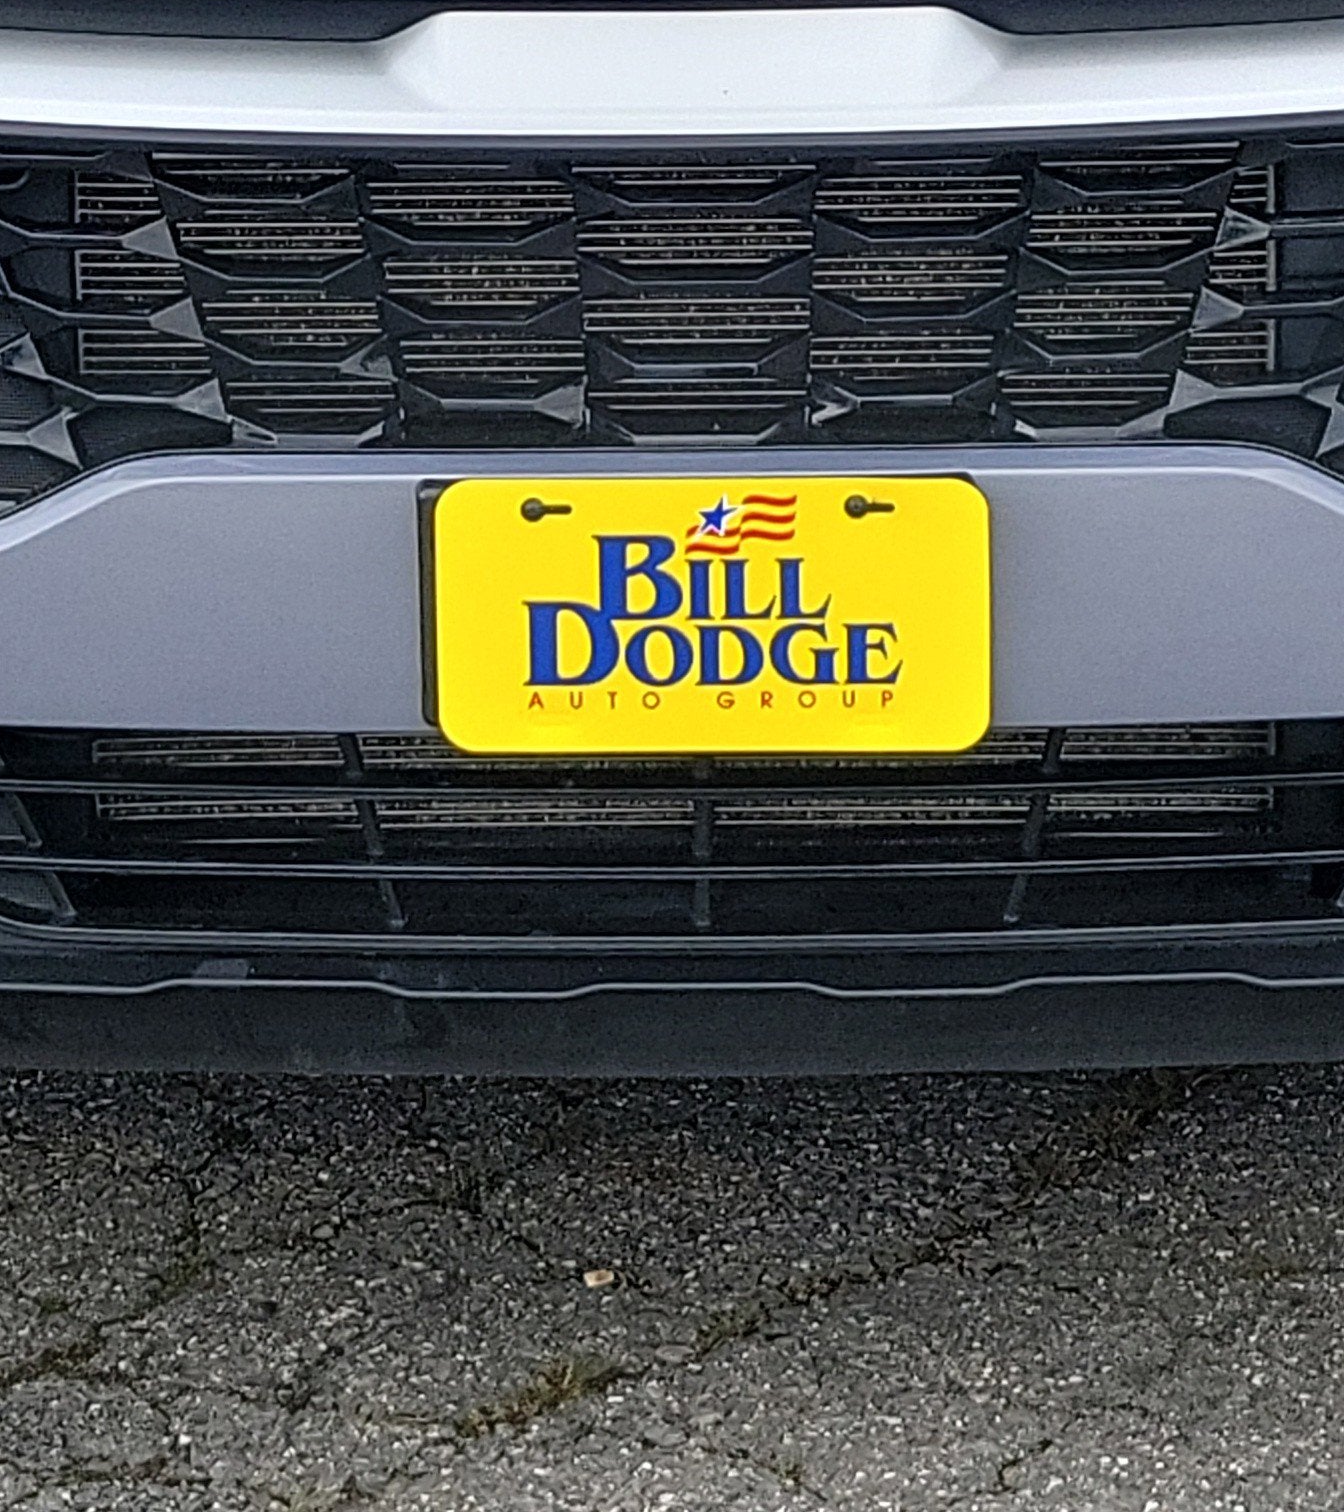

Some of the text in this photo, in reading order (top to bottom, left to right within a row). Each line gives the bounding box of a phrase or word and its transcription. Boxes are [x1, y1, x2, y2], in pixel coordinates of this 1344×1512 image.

[592, 534, 832, 621] BILL
[522, 600, 904, 686] DODGE
[527, 690, 895, 710] AUTO GROUP
